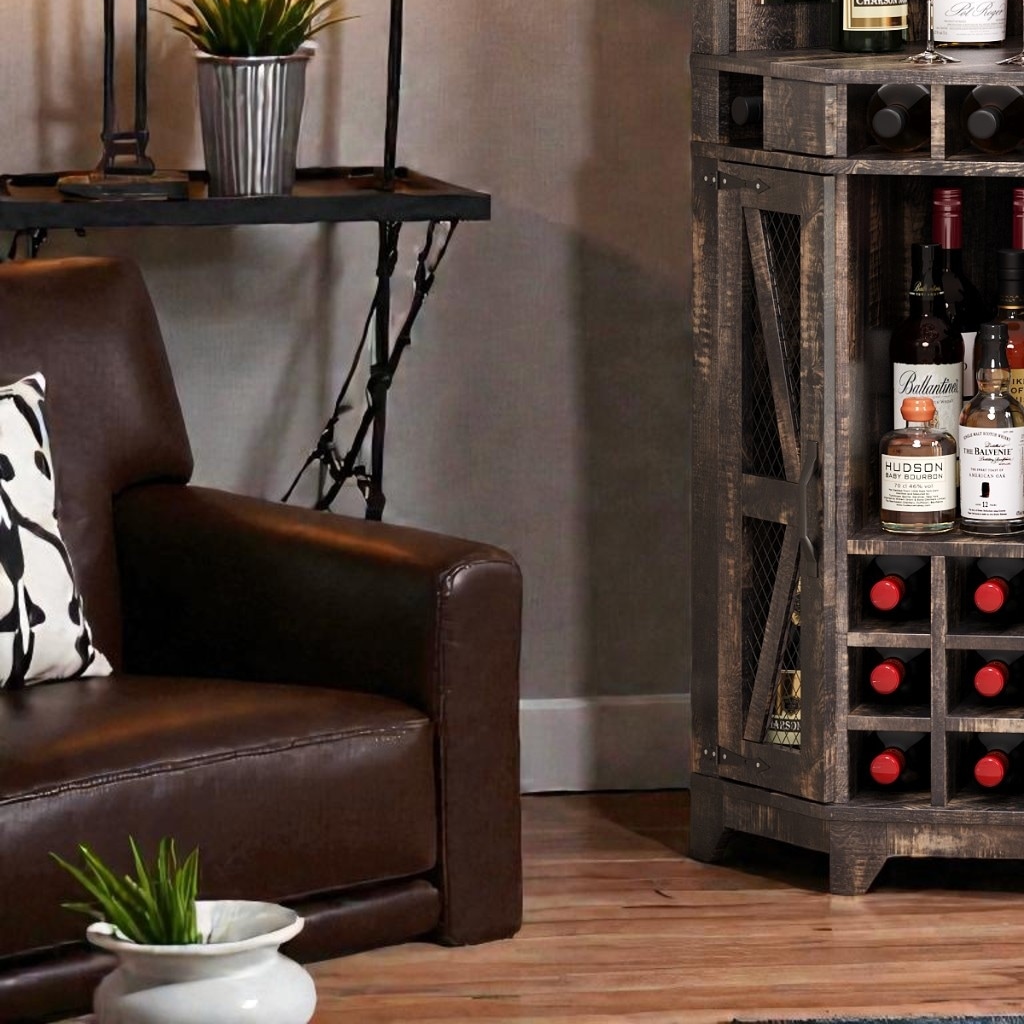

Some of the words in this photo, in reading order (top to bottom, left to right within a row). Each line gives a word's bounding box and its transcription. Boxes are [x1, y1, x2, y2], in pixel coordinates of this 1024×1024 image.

[898, 370, 959, 395] Ballantine's
[974, 447, 1011, 456] BALVENIE
[885, 462, 943, 473] HUDSON
